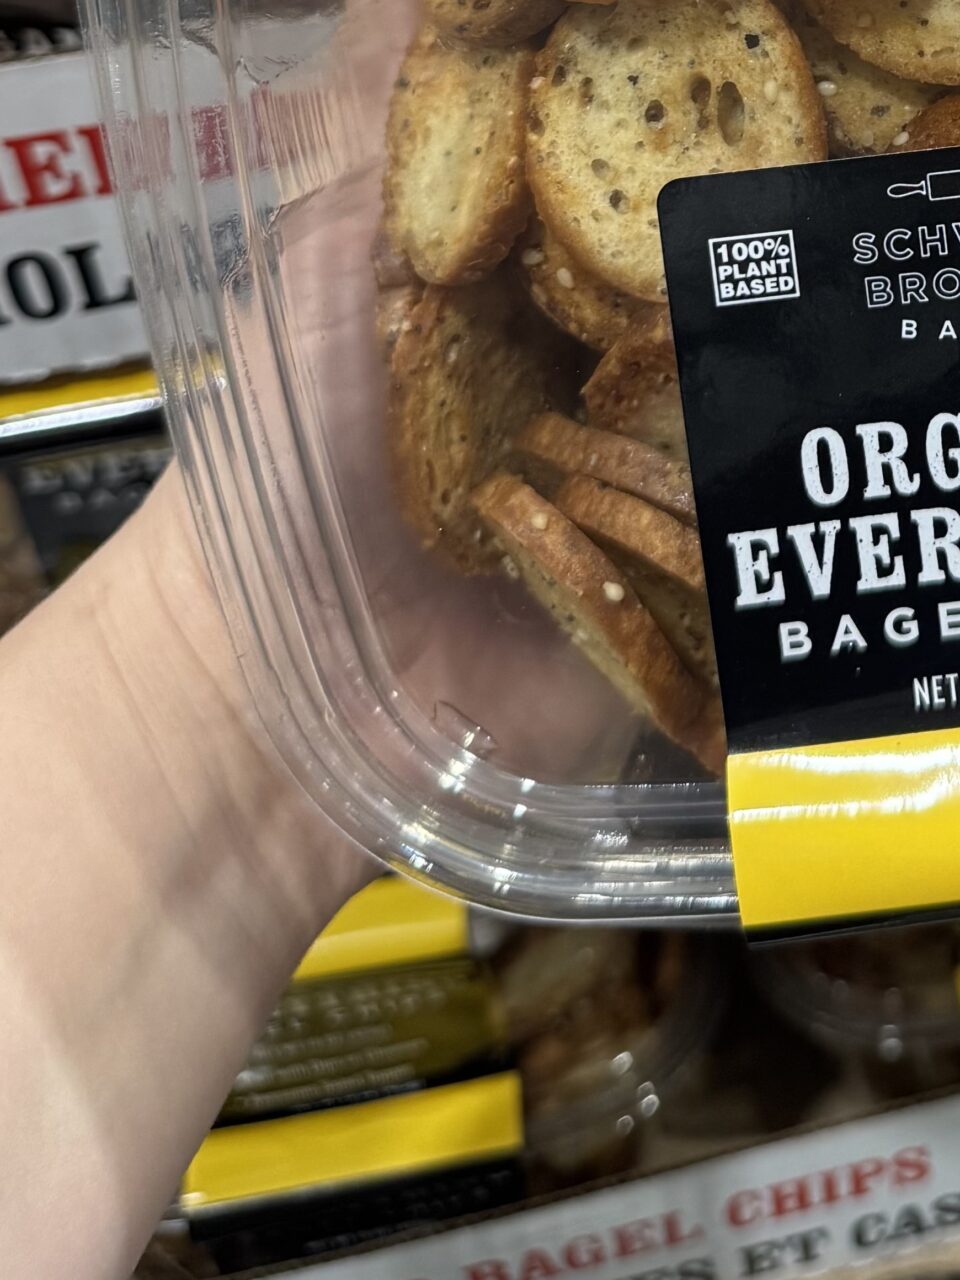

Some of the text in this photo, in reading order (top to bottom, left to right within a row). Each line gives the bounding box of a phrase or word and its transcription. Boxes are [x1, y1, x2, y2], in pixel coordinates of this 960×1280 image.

[717, 236, 790, 262] 100%
[719, 258, 792, 280] PLANT
[720, 277, 794, 298] BASED
[914, 673, 959, 708] NET
[724, 1144, 932, 1230] CHIPS
